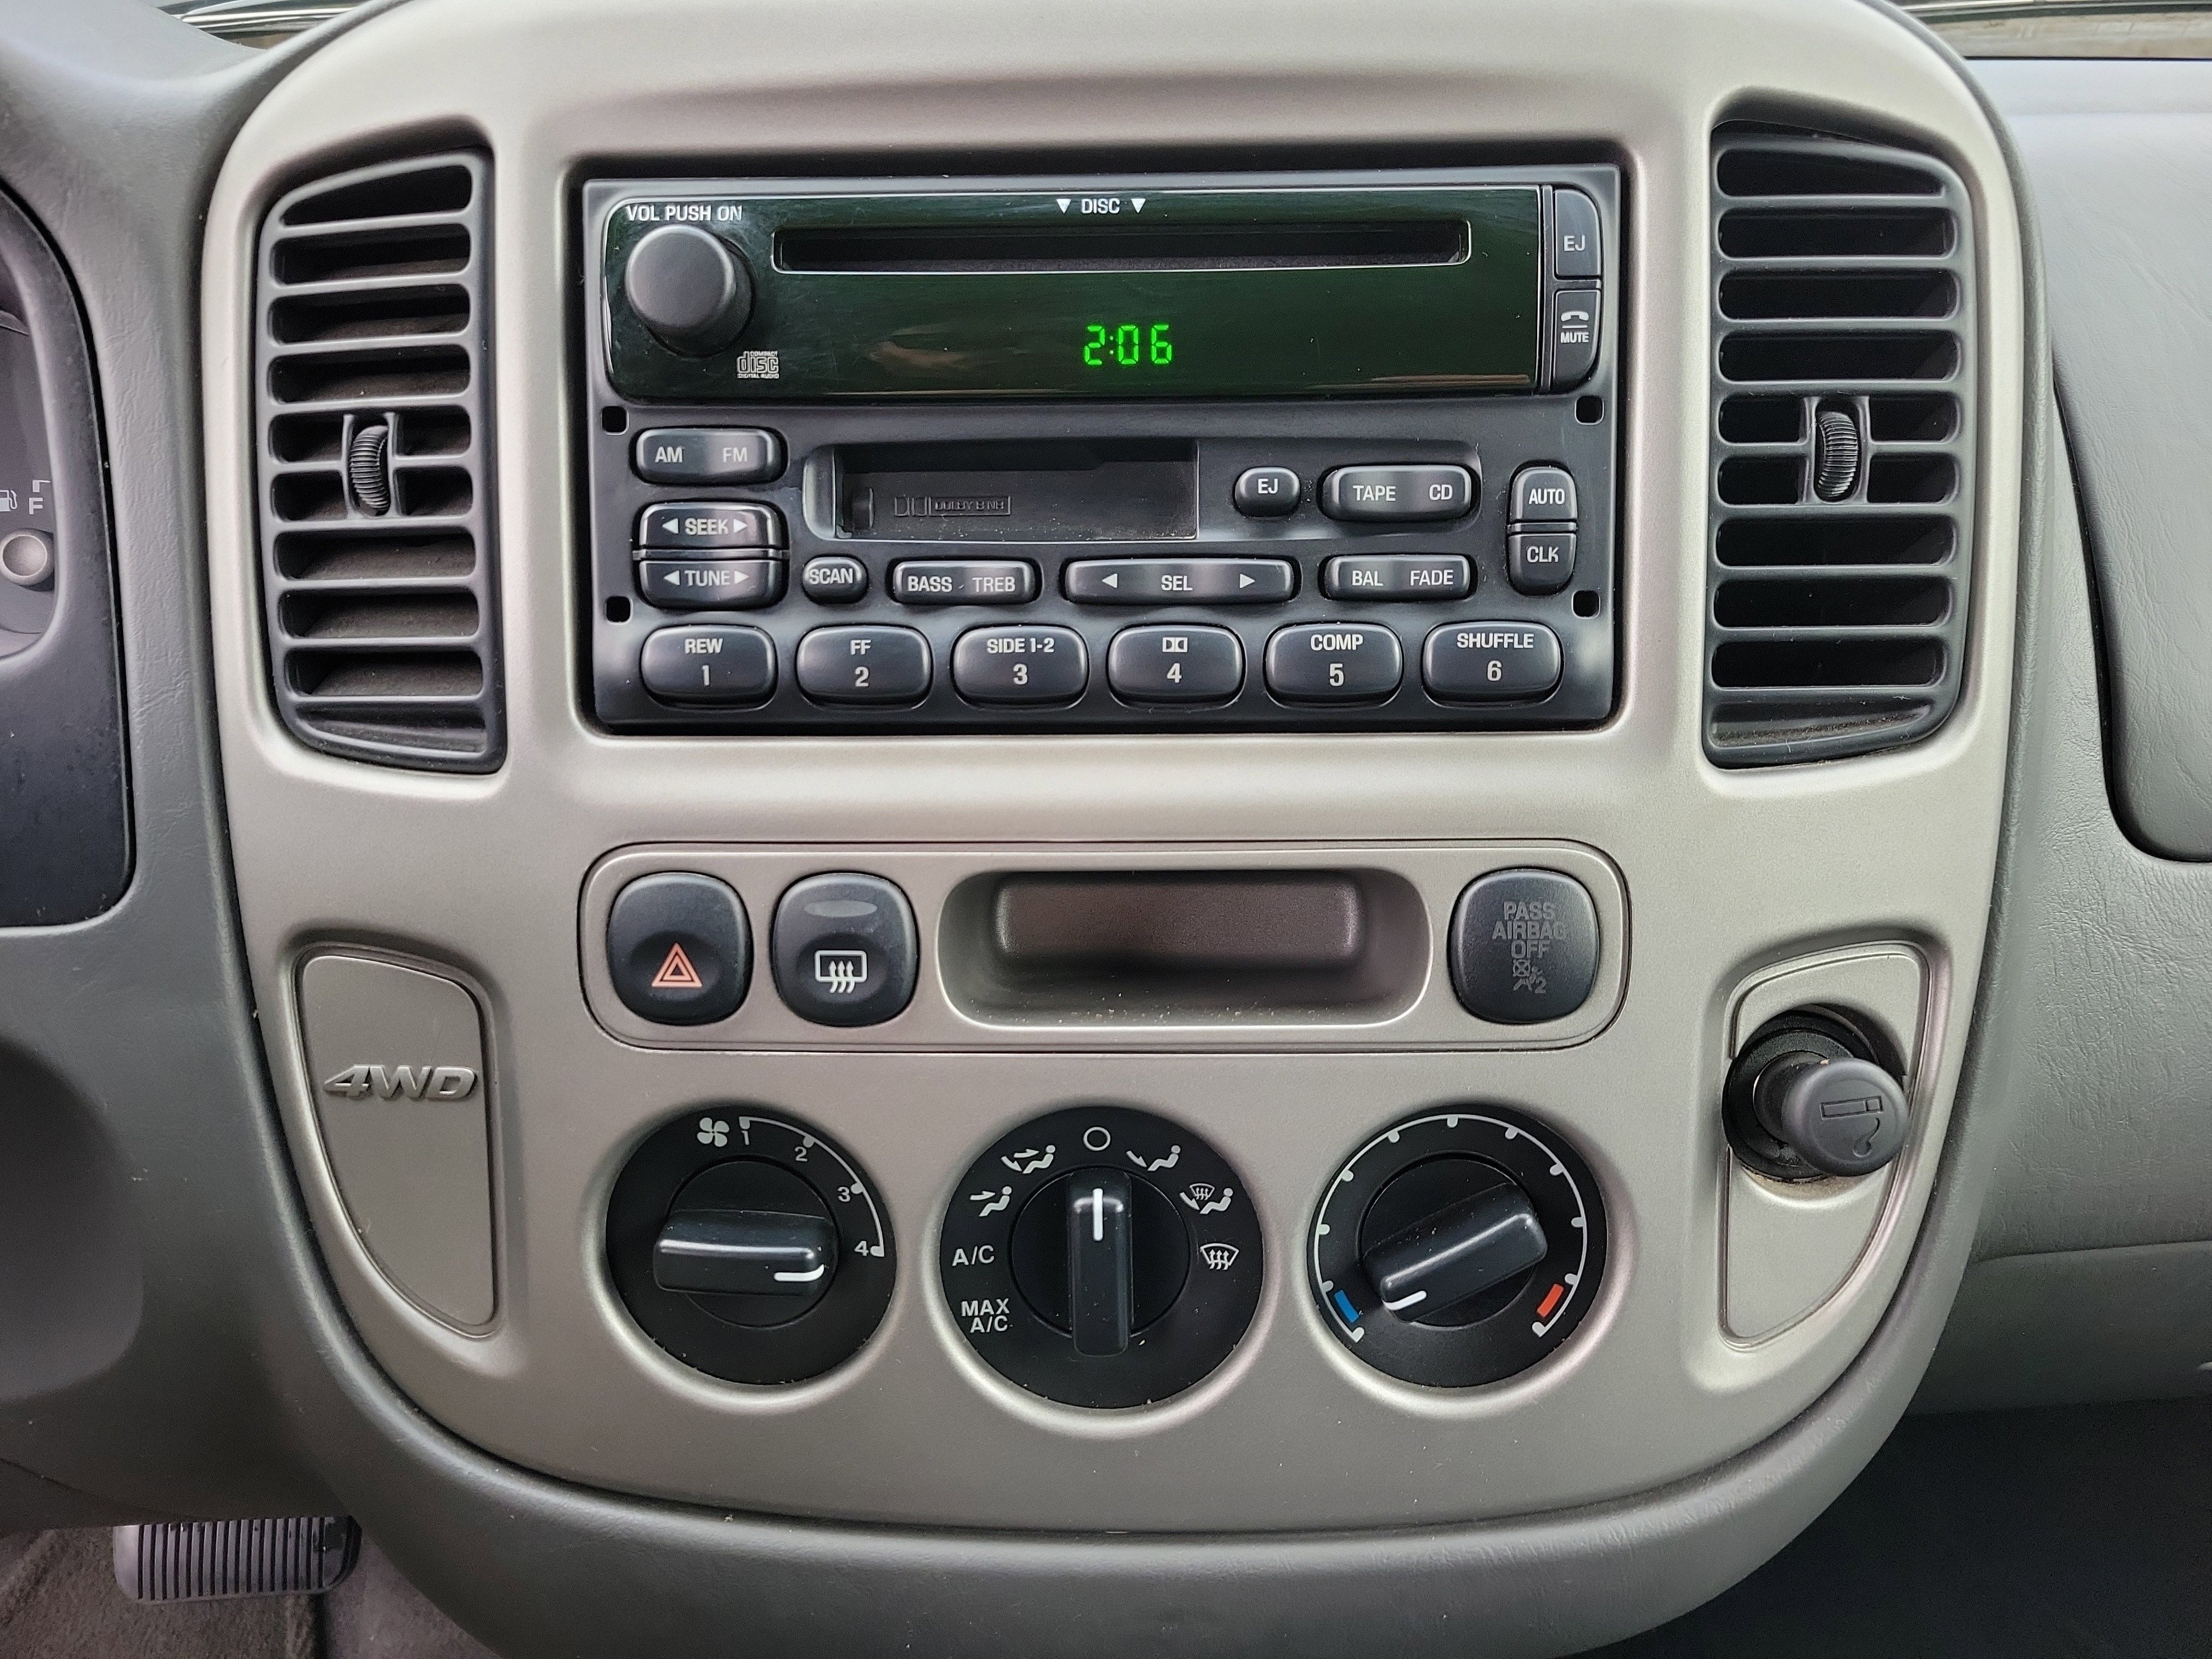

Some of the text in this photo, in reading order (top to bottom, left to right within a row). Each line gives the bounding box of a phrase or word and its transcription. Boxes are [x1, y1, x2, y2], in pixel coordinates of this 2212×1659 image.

[625, 205, 742, 221] VOL PUSH ON
[1081, 199, 1120, 214] DISC
[1564, 235, 1586, 251] EJ
[1084, 324, 1172, 365] 2:06
[1560, 332, 1589, 343] MUTE
[654, 447, 683, 462] AM
[723, 447, 748, 462] FM
[1258, 478, 1279, 494] EJ
[1353, 485, 1396, 502] TAPE
[1429, 484, 1453, 501] CD
[1528, 488, 1566, 505] AUTO
[29, 498, 43, 515] F
[685, 518, 729, 535] SEEK
[1526, 546, 1559, 563] CLK
[684, 570, 730, 586] TUNE
[809, 568, 854, 585] SCAN
[907, 576, 953, 592] BASS
[972, 577, 1015, 592] TREB
[1161, 575, 1193, 591] SEL
[1352, 570, 1384, 587] BAL
[1409, 569, 1454, 586] FADE
[685, 639, 723, 654] REW
[850, 639, 871, 656] FF
[987, 637, 1054, 653] SIDE 1-2
[1311, 634, 1363, 651] COMP
[1457, 633, 1534, 648] SHUFFLE
[702, 665, 710, 686] 1
[854, 667, 869, 687] 2
[1013, 663, 1028, 685] 3
[1166, 663, 1182, 683] 4
[1329, 663, 1344, 687] 5
[1487, 660, 1502, 681] 6
[1504, 901, 1556, 920] PASS
[1492, 921, 1567, 939] AIRBAG
[1511, 940, 1551, 958] OFF
[324, 1064, 476, 1098] 4WD
[741, 1130, 750, 1146] 1
[794, 1147, 808, 1162] 2
[837, 1187, 851, 1202] 3
[854, 1240, 869, 1256] 4
[952, 1245, 995, 1266] A/C
[961, 1298, 1010, 1317] MAX
[970, 1315, 1008, 1333] A/C
